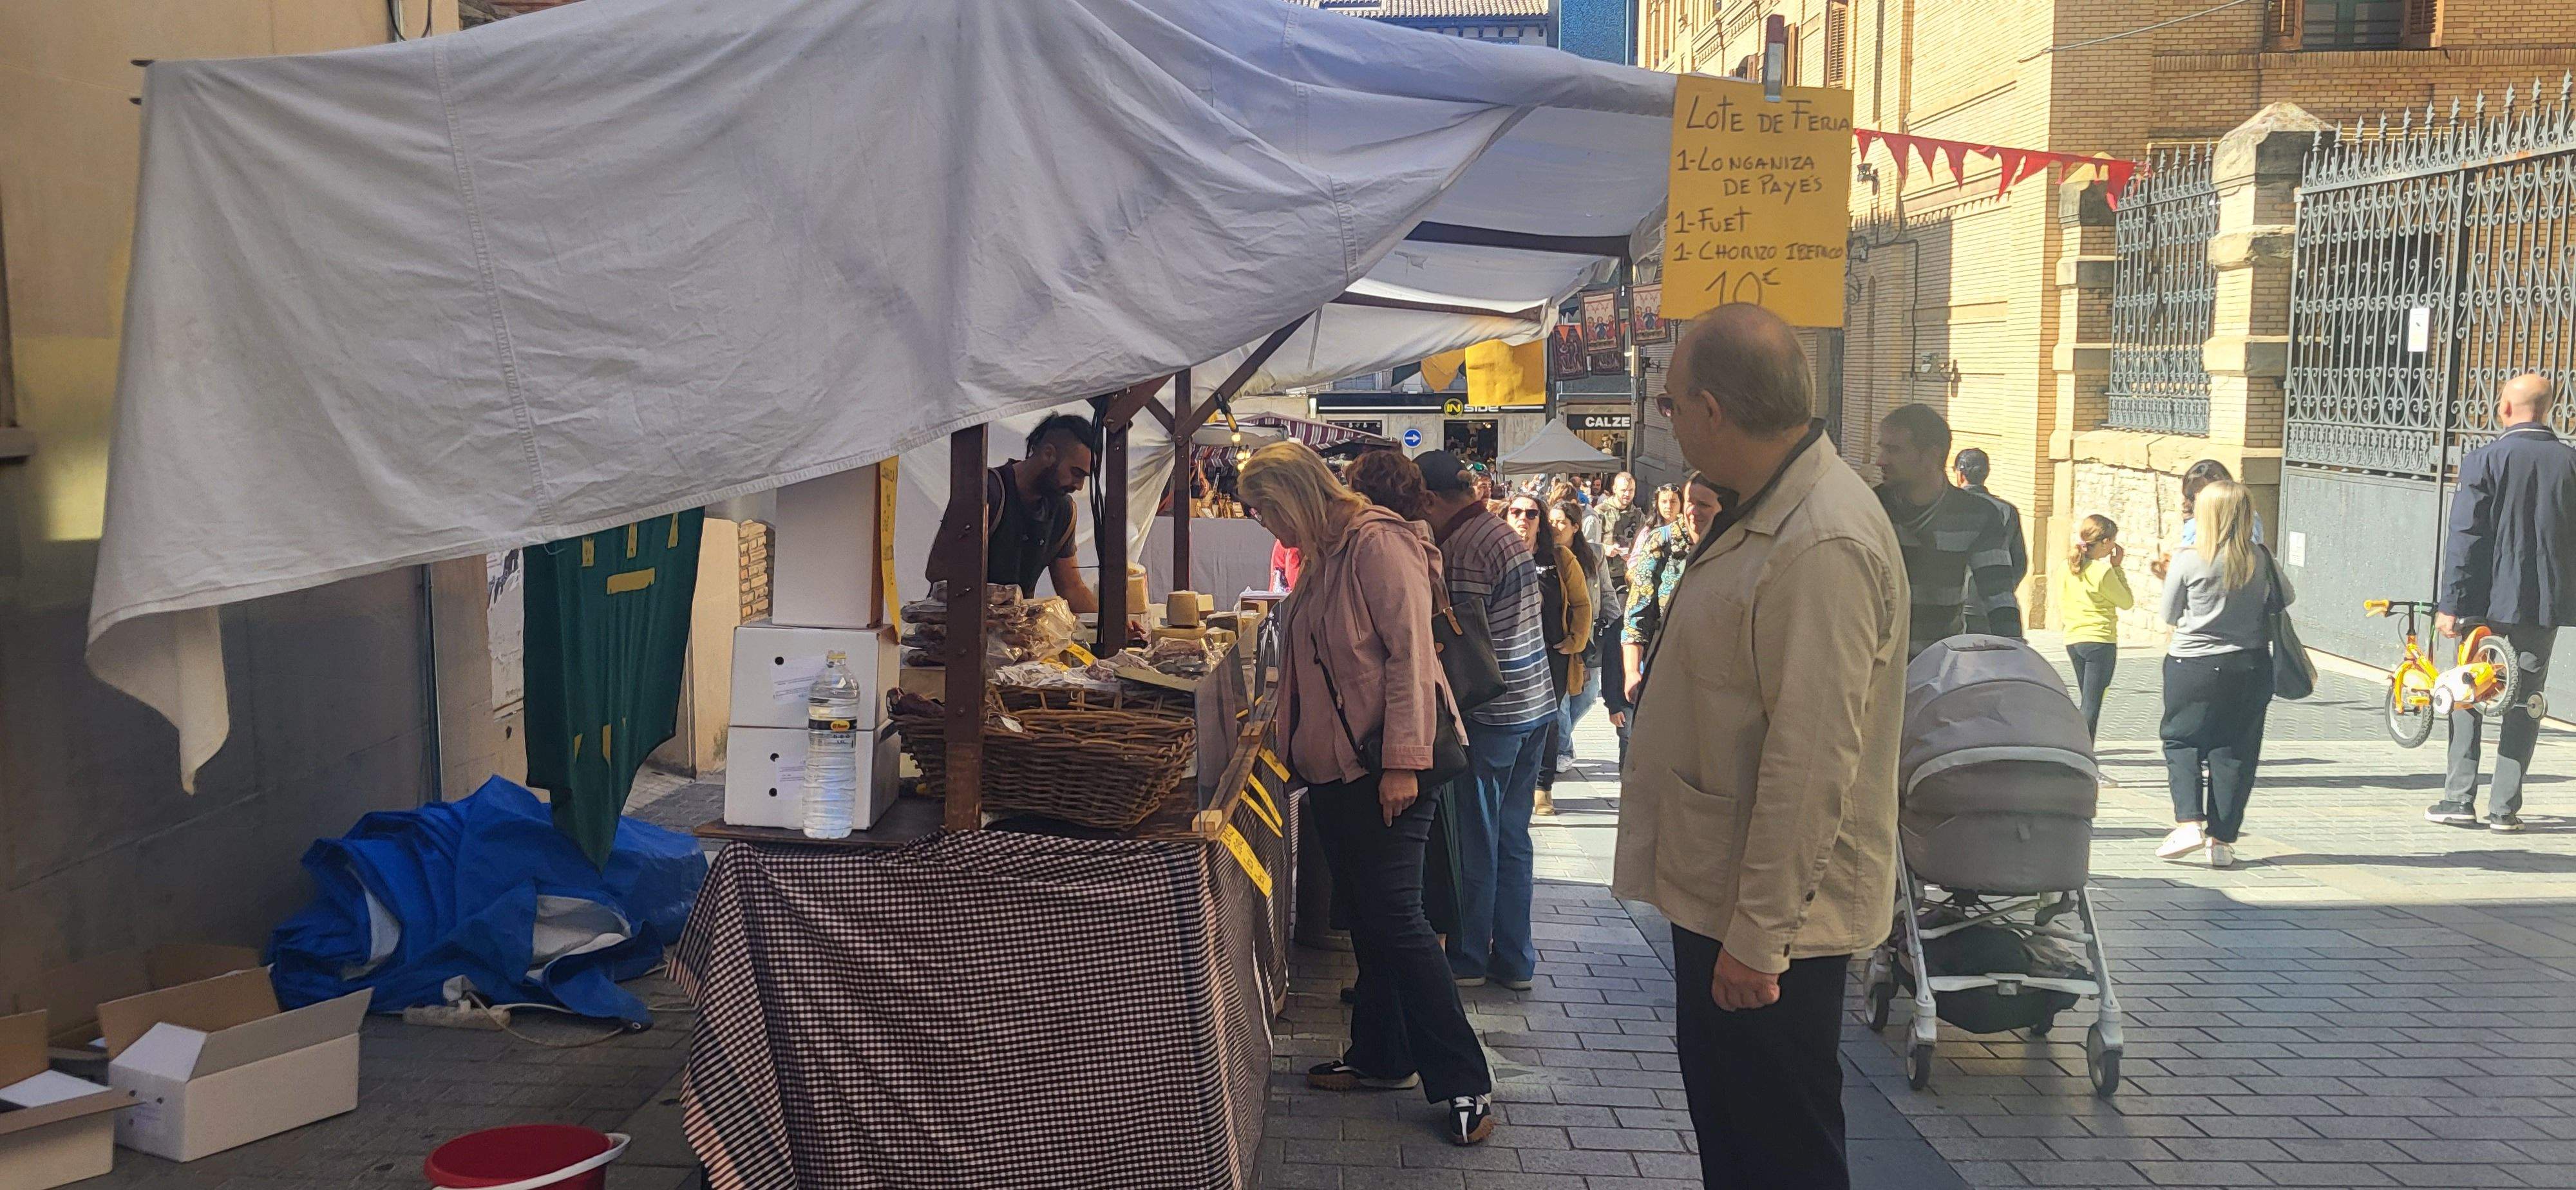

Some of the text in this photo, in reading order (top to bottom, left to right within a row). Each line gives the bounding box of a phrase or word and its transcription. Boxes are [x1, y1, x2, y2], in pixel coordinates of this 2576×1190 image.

[1757, 113, 1783, 133] DE
[1786, 100, 1850, 131] FERIA
[1722, 174, 1823, 205] DE PAYÉS
[1585, 417, 1631, 427] CALZE
